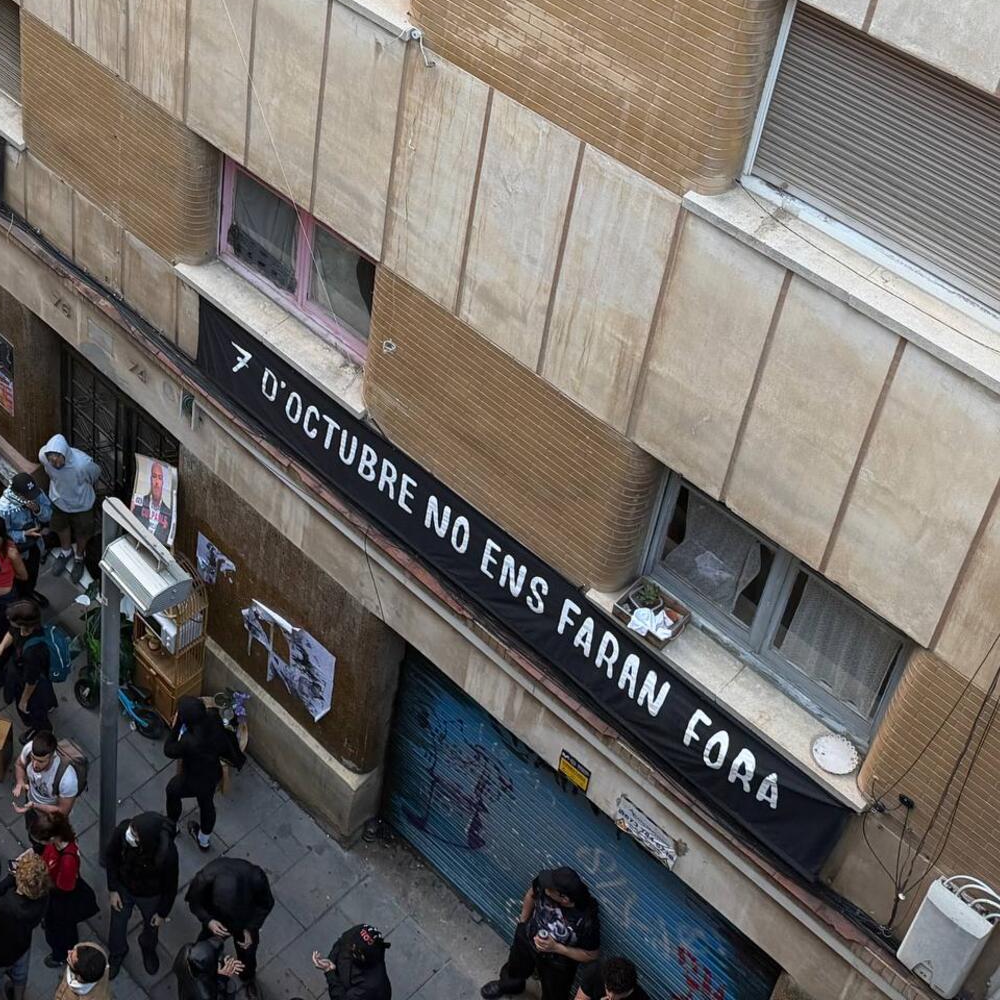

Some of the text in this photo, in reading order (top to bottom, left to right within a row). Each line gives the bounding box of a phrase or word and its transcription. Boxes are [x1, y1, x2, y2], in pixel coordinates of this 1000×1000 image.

[231, 341, 253, 373] 7
[261, 367, 418, 514] D'OCTUBRE
[424, 495, 470, 554] NO
[480, 538, 549, 614] ENS
[557, 598, 671, 717] FARAN
[683, 708, 779, 809] FORA
